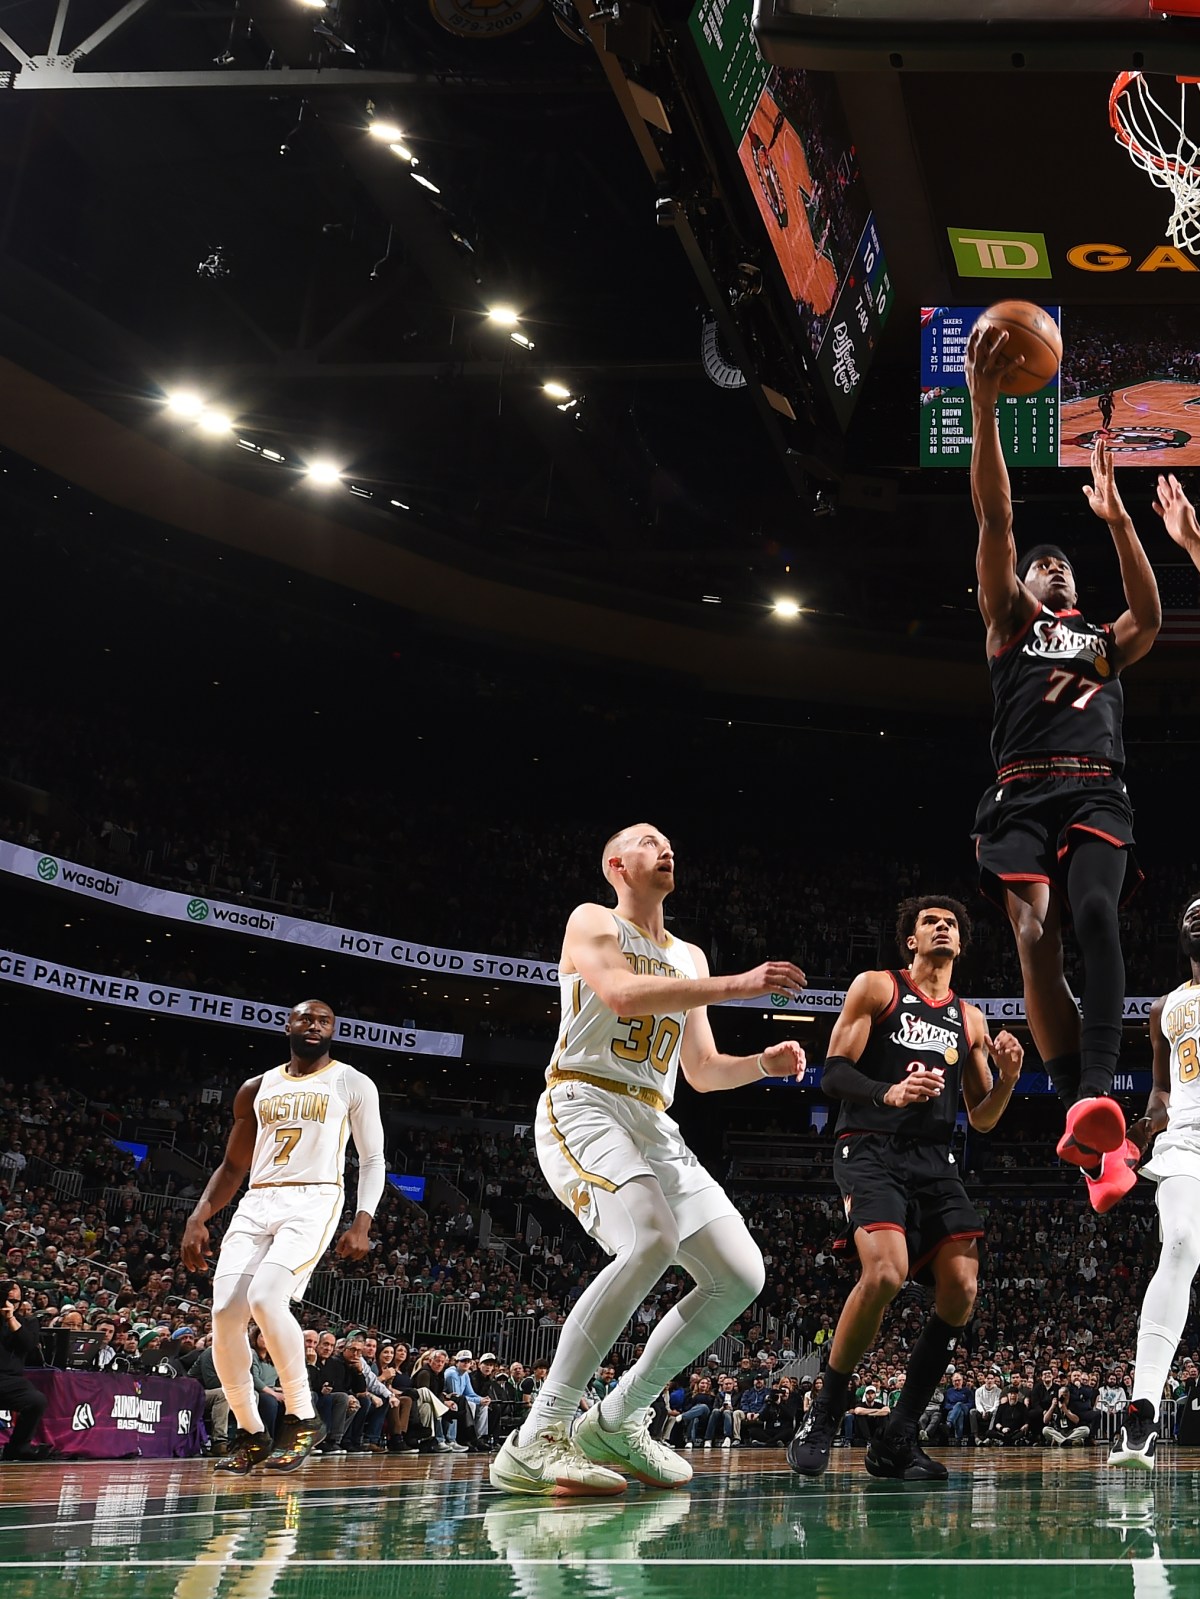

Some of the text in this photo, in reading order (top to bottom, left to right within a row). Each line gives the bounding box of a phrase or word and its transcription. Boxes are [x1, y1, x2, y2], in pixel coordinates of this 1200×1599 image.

[959, 237, 1039, 269] TD
[943, 327, 962, 335] MAXEY
[833, 320, 861, 386] Different
[832, 360, 853, 394] Here
[942, 408, 962, 416] BROWN
[942, 418, 960, 426] WHITE
[942, 427, 964, 435] HAUSER
[1028, 620, 1108, 659] SIXERS
[1043, 668, 1104, 710] 77
[62, 867, 120, 896] wasabi
[213, 907, 558, 982] wasabi HOT CLOUD STORAG
[34, 964, 140, 1002] PARTNER
[148, 989, 181, 1008] OF
[189, 995, 233, 1017] THE
[339, 1023, 416, 1047] BRUINS
[794, 994, 846, 1007] wasabi
[611, 1014, 681, 1076] 30
[896, 1012, 959, 1050] SIXERS
[259, 1092, 329, 1129] BOSTON
[274, 1128, 302, 1166] 7
